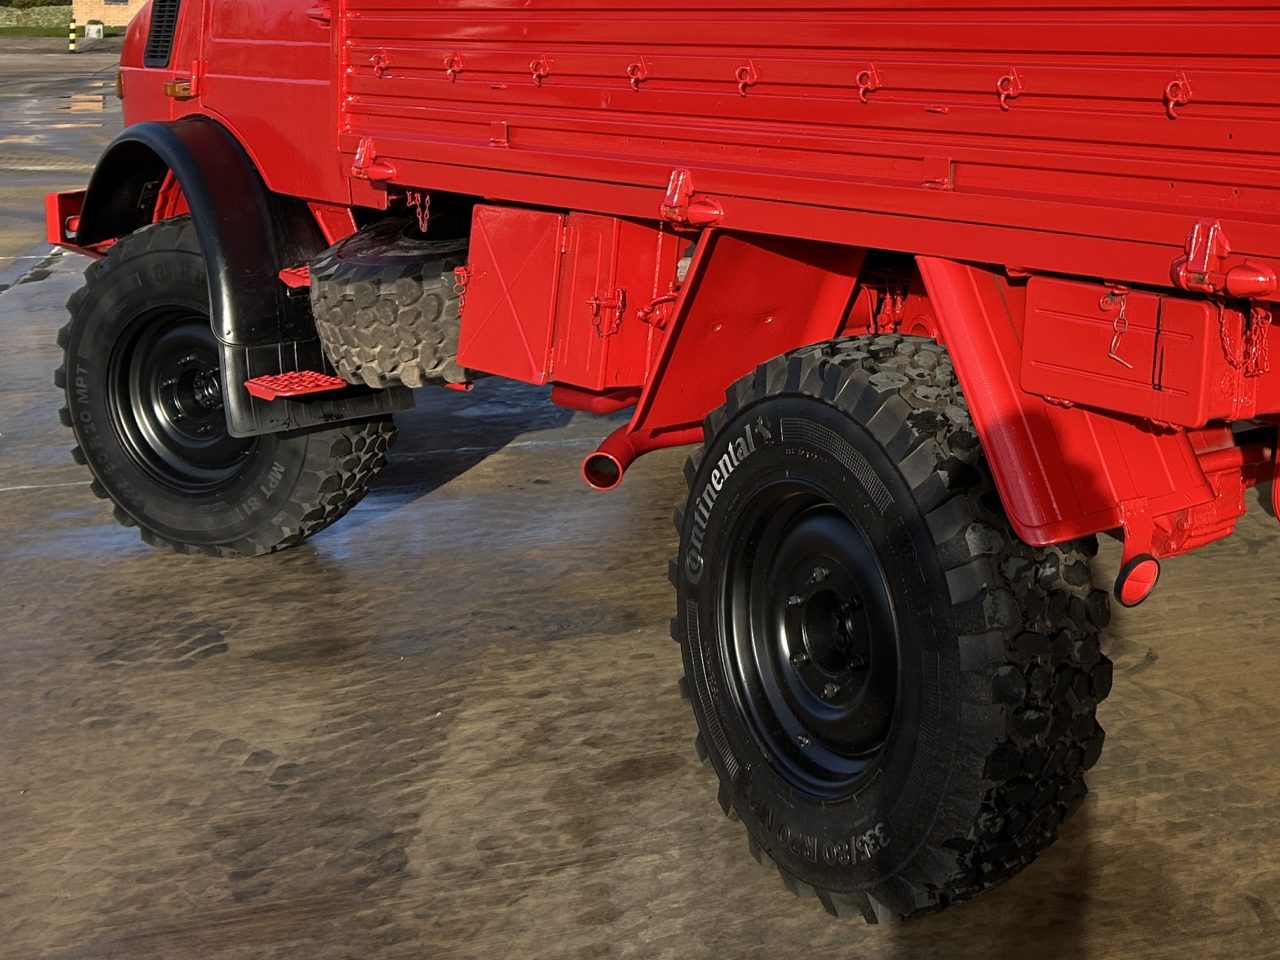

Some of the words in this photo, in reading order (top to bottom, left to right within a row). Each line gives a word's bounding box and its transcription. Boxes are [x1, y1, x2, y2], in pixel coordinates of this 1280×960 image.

[75, 364, 88, 403] MPT
[260, 461, 285, 499] MPT
[242, 497, 261, 516] 81
[685, 424, 756, 584] Continental
